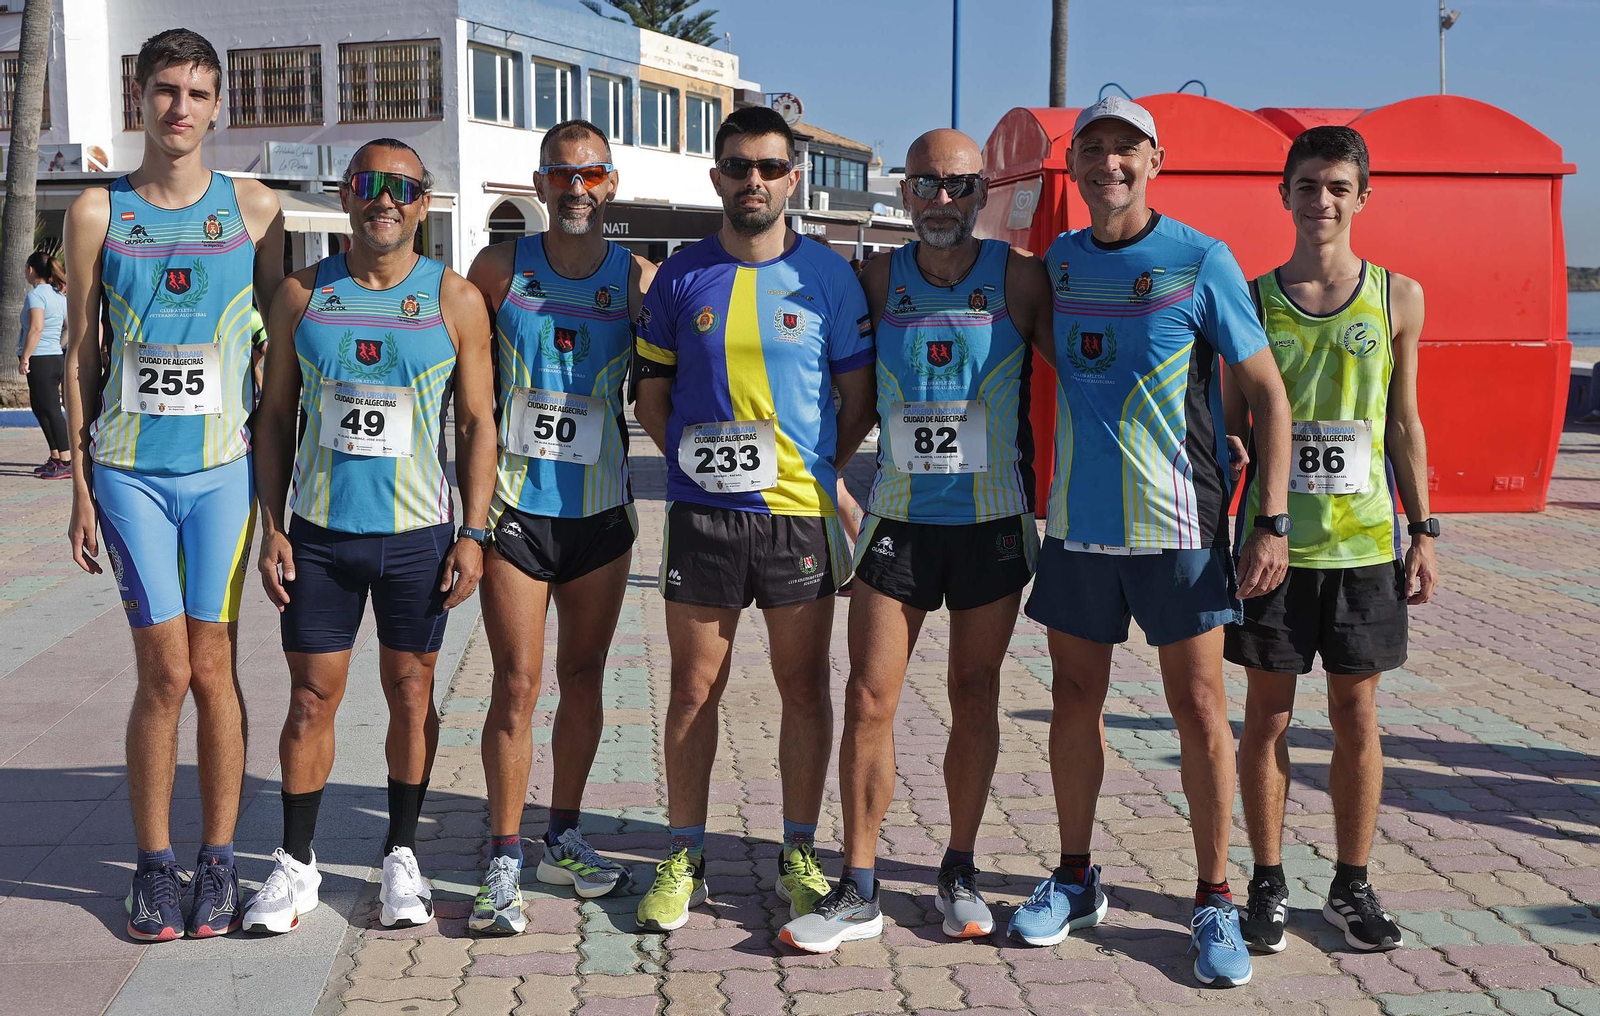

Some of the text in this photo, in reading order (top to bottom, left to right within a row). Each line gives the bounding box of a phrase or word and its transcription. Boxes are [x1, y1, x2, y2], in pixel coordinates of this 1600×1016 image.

[602, 222, 629, 234] NATI
[138, 368, 204, 396] 255
[335, 387, 397, 400] CARRERA URBANA
[335, 394, 354, 404] CIUDAD
[365, 398, 396, 407] ALGECIRAS
[528, 395, 588, 408] CARRERA URBANA
[528, 401, 548, 410] CIUDAD
[558, 405, 588, 416] ALGECIRAS
[340, 408, 385, 436] 49
[534, 414, 576, 442] 50
[725, 426, 756, 435] URBANA
[725, 433, 757, 442] ALGECIRAS
[914, 426, 957, 454] 82
[694, 445, 760, 473] 233
[1299, 446, 1345, 473] 86
